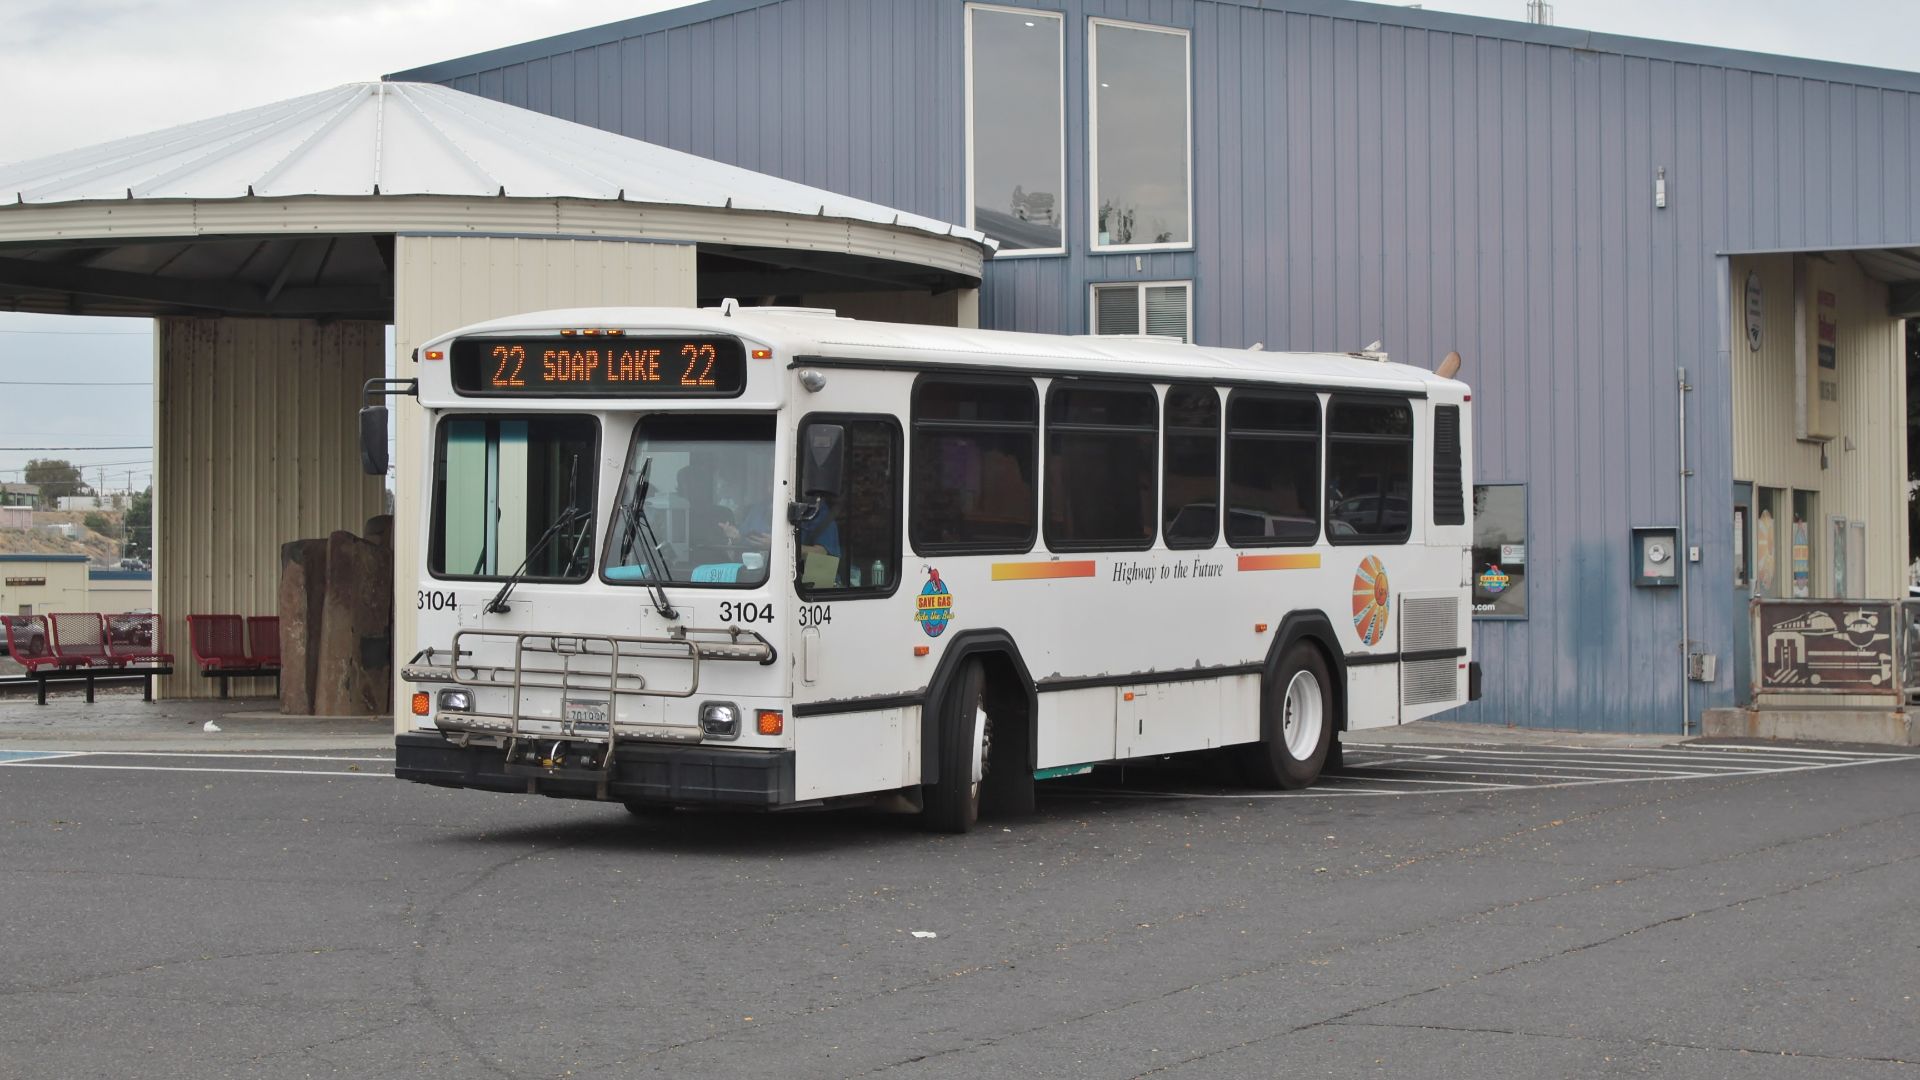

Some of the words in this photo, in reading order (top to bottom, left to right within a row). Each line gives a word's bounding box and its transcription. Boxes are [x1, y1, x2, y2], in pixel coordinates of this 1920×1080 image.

[493, 346, 525, 386] 22
[543, 350, 598, 381] SOAP
[607, 350, 661, 381] LAKE
[681, 344, 716, 385] 22
[1112, 561, 1157, 585] Highway
[1160, 564, 1170, 580] to
[1173, 560, 1189, 579] the
[1192, 558, 1224, 578] Future
[416, 590, 458, 611] 3104
[918, 597, 935, 608] SAVE
[937, 595, 951, 607] GAS
[719, 601, 775, 623] 3104
[798, 604, 832, 626] 3104
